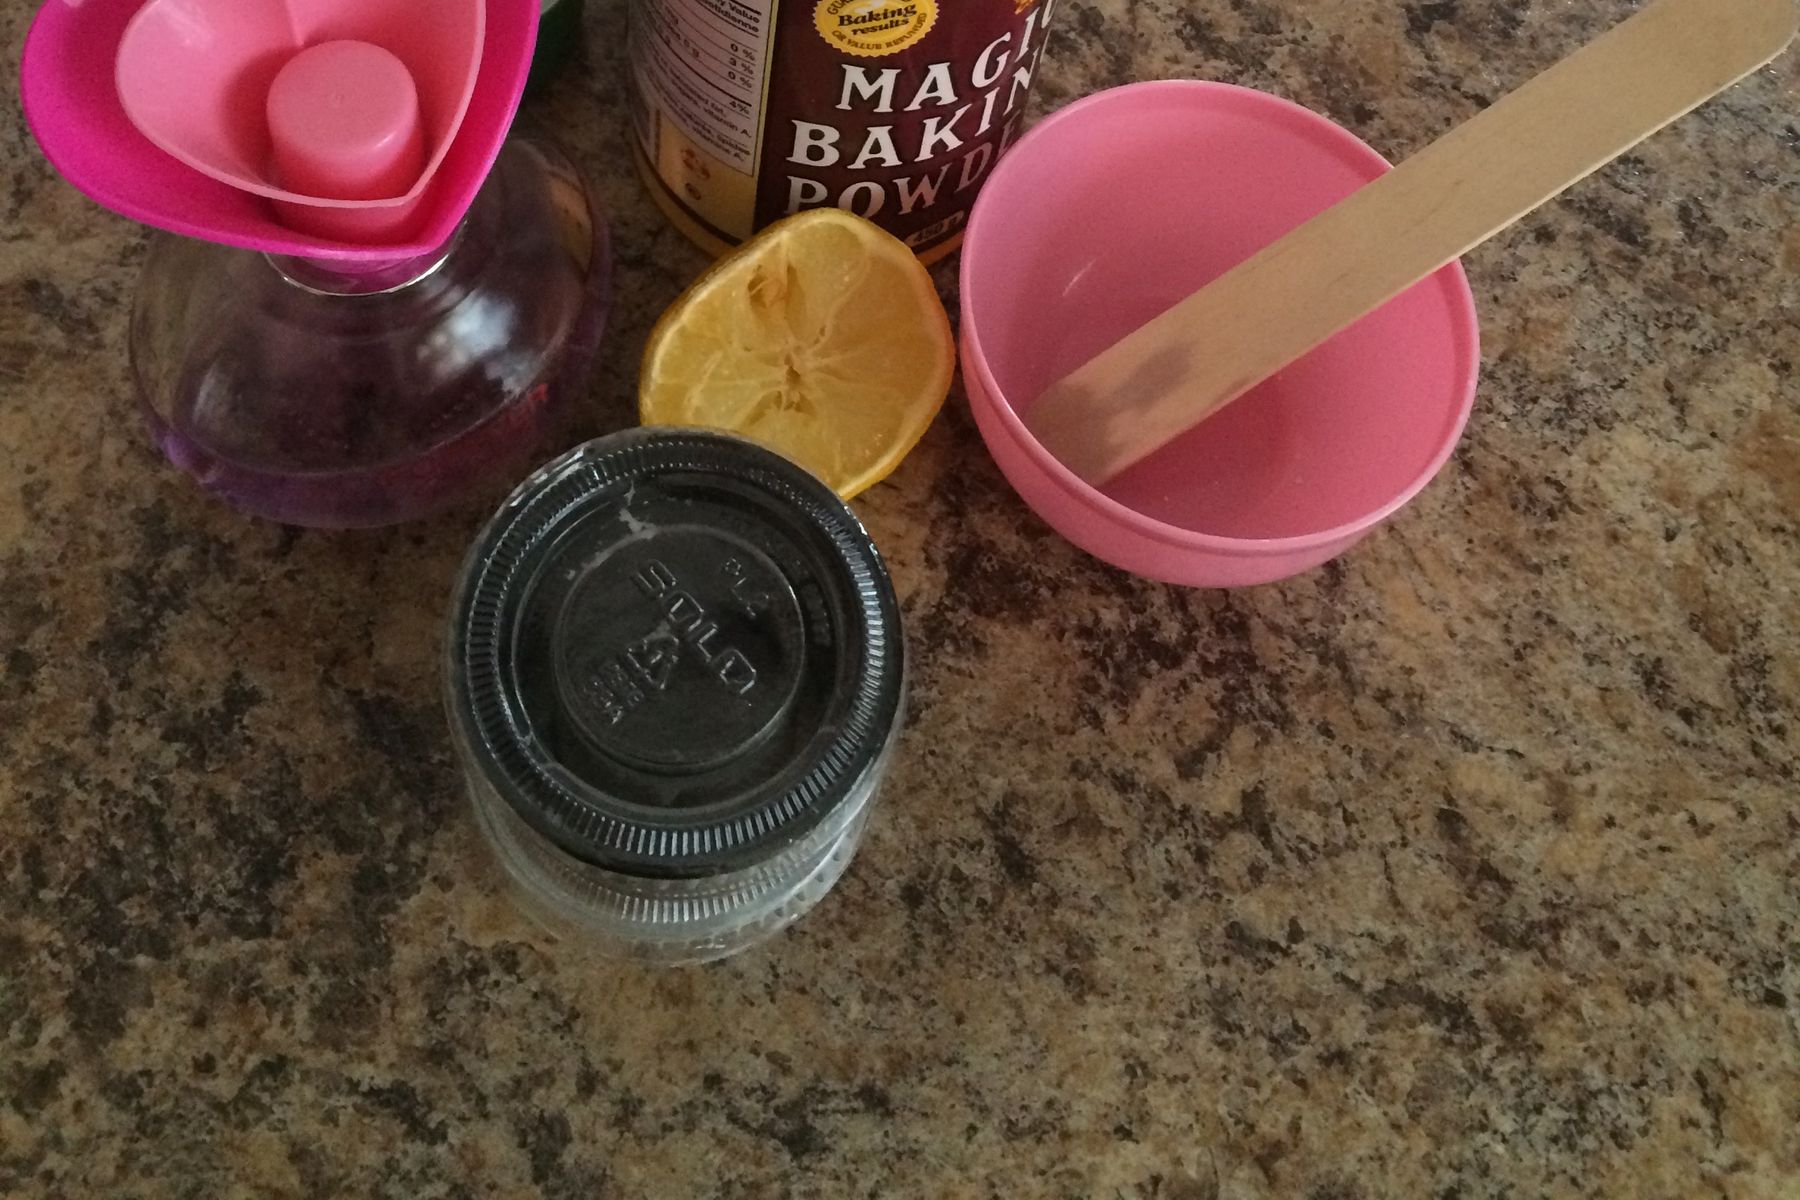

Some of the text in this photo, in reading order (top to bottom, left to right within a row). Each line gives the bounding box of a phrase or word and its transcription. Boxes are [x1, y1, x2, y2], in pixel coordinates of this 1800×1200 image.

[728, 2, 760, 24] Value
[838, 4, 917, 27] Baking
[851, 18, 910, 35] results
[847, 39, 882, 50] VALUE
[786, 32, 1048, 169] BAKIN
[783, 108, 1024, 219] POWDE
[634, 558, 757, 695] SOLO
